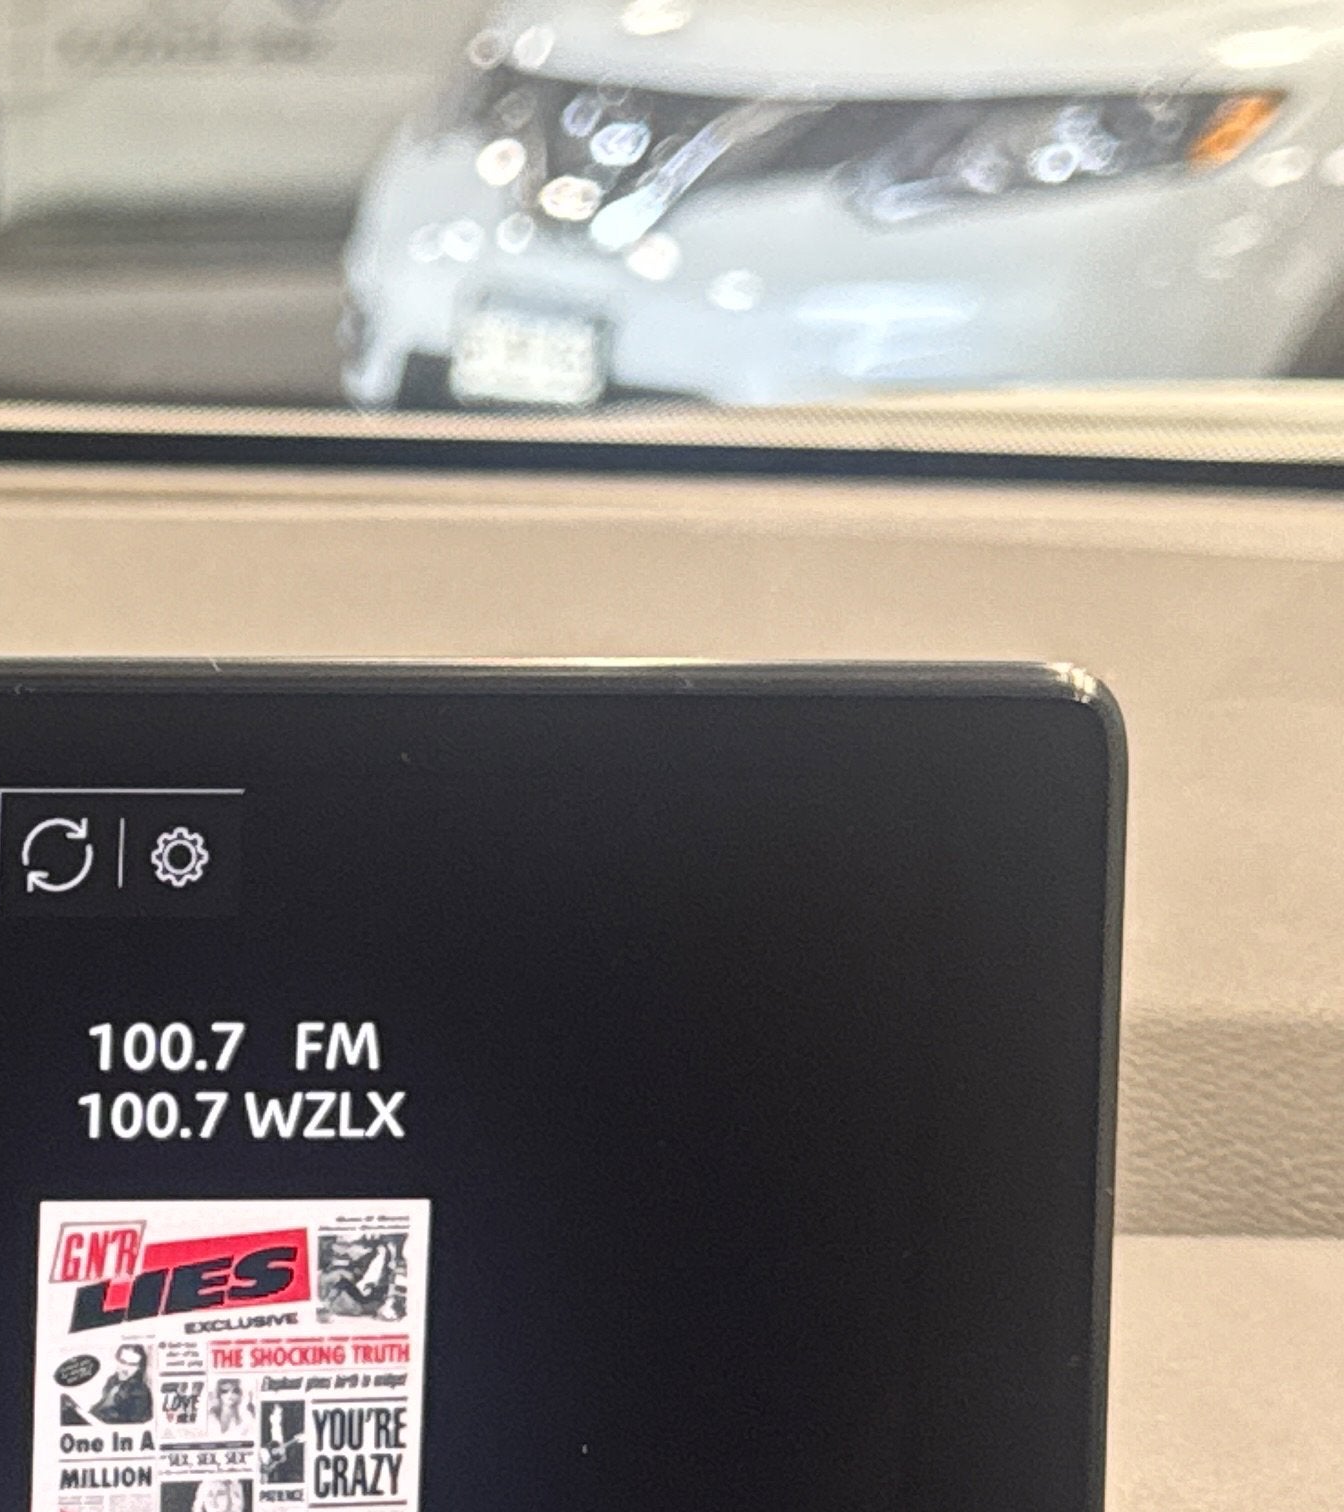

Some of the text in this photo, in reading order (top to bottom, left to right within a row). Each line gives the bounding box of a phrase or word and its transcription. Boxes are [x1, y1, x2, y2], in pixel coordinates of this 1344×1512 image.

[89, 1022, 379, 1071] 100.7 FM
[79, 1091, 405, 1138] 100.7 WZLX
[68, 1246, 298, 1334] LIES
[184, 1312, 299, 1335] EXCLUSIVE
[212, 1348, 242, 1369] THE
[250, 1346, 345, 1368] SHOCKING
[353, 1343, 410, 1364] TRUTH
[60, 1430, 155, 1454] One In A
[313, 1407, 408, 1452] YOU'RE
[59, 1466, 152, 1489] MILLION
[315, 1453, 404, 1499] CRAZY
